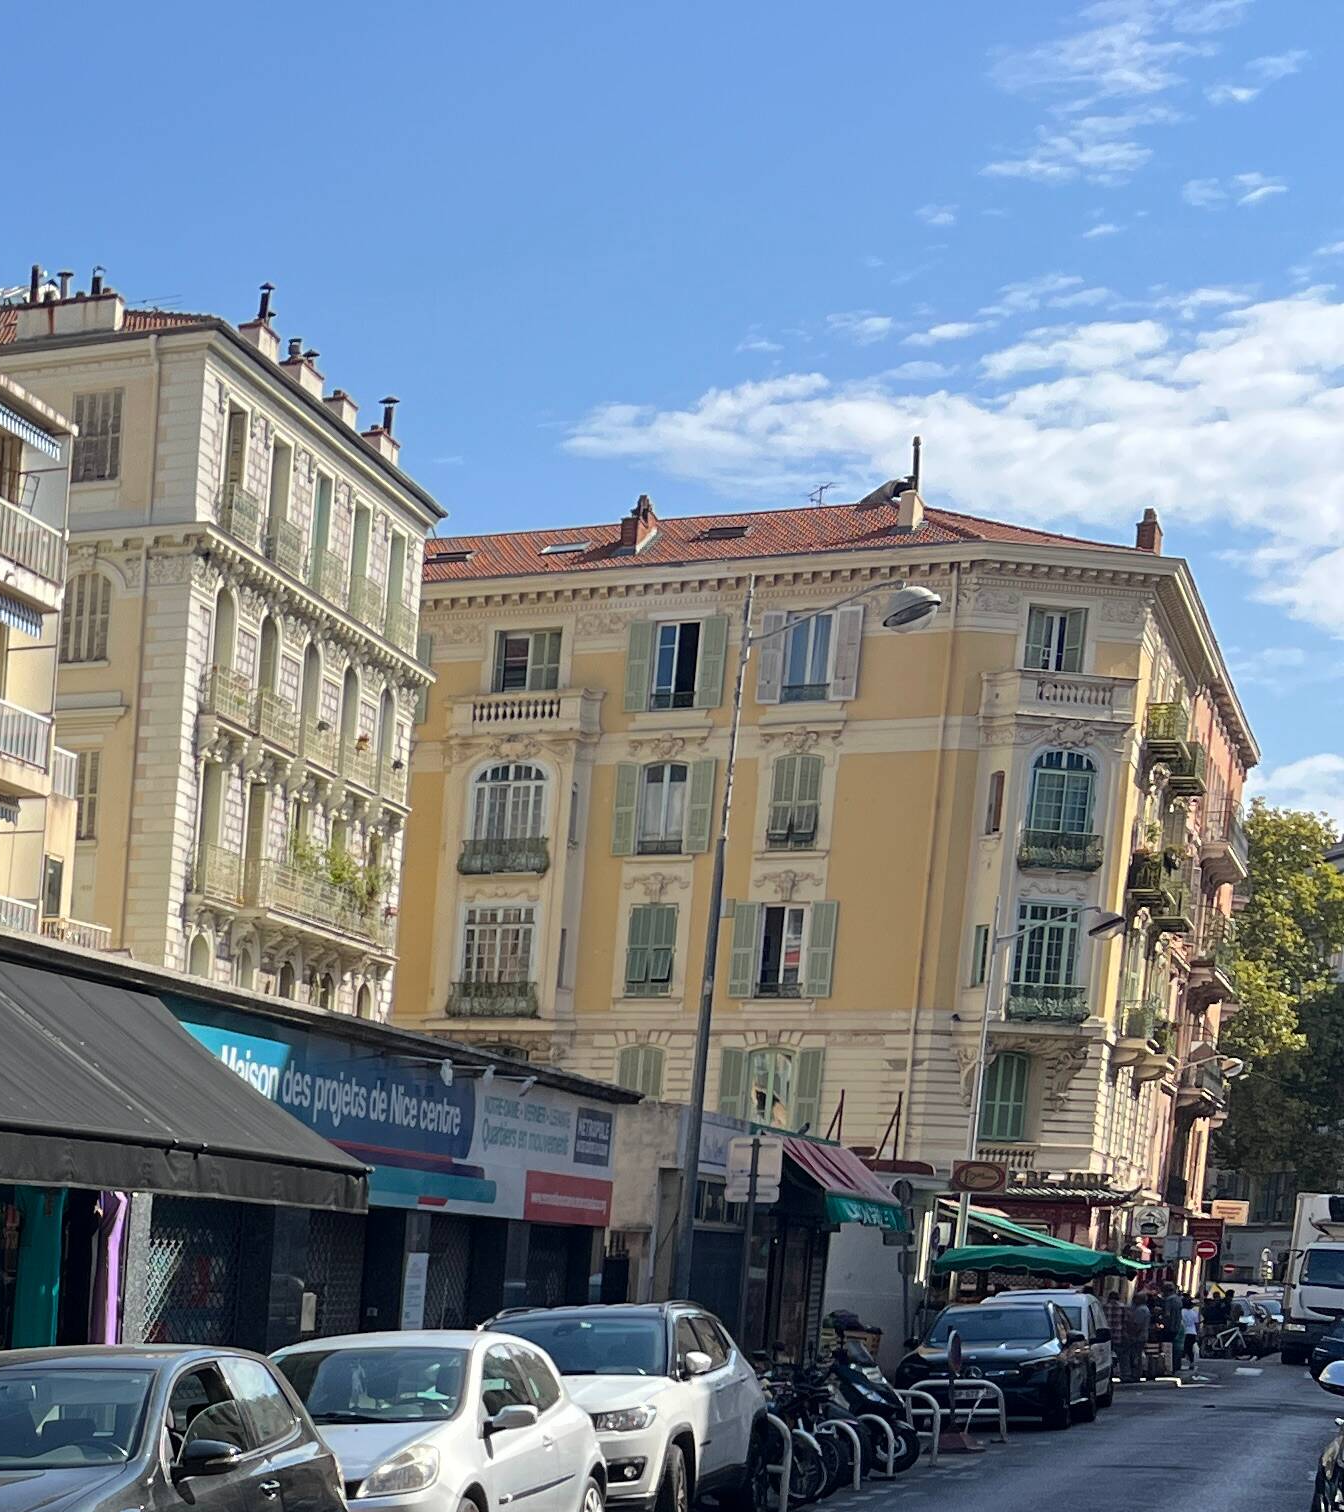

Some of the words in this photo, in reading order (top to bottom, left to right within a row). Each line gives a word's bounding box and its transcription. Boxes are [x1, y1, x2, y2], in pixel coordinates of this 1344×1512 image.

[282, 1060, 312, 1107] des
[313, 1072, 367, 1128] projets
[369, 1080, 387, 1122] de
[389, 1083, 417, 1128] Nice
[419, 1098, 462, 1136] centre
